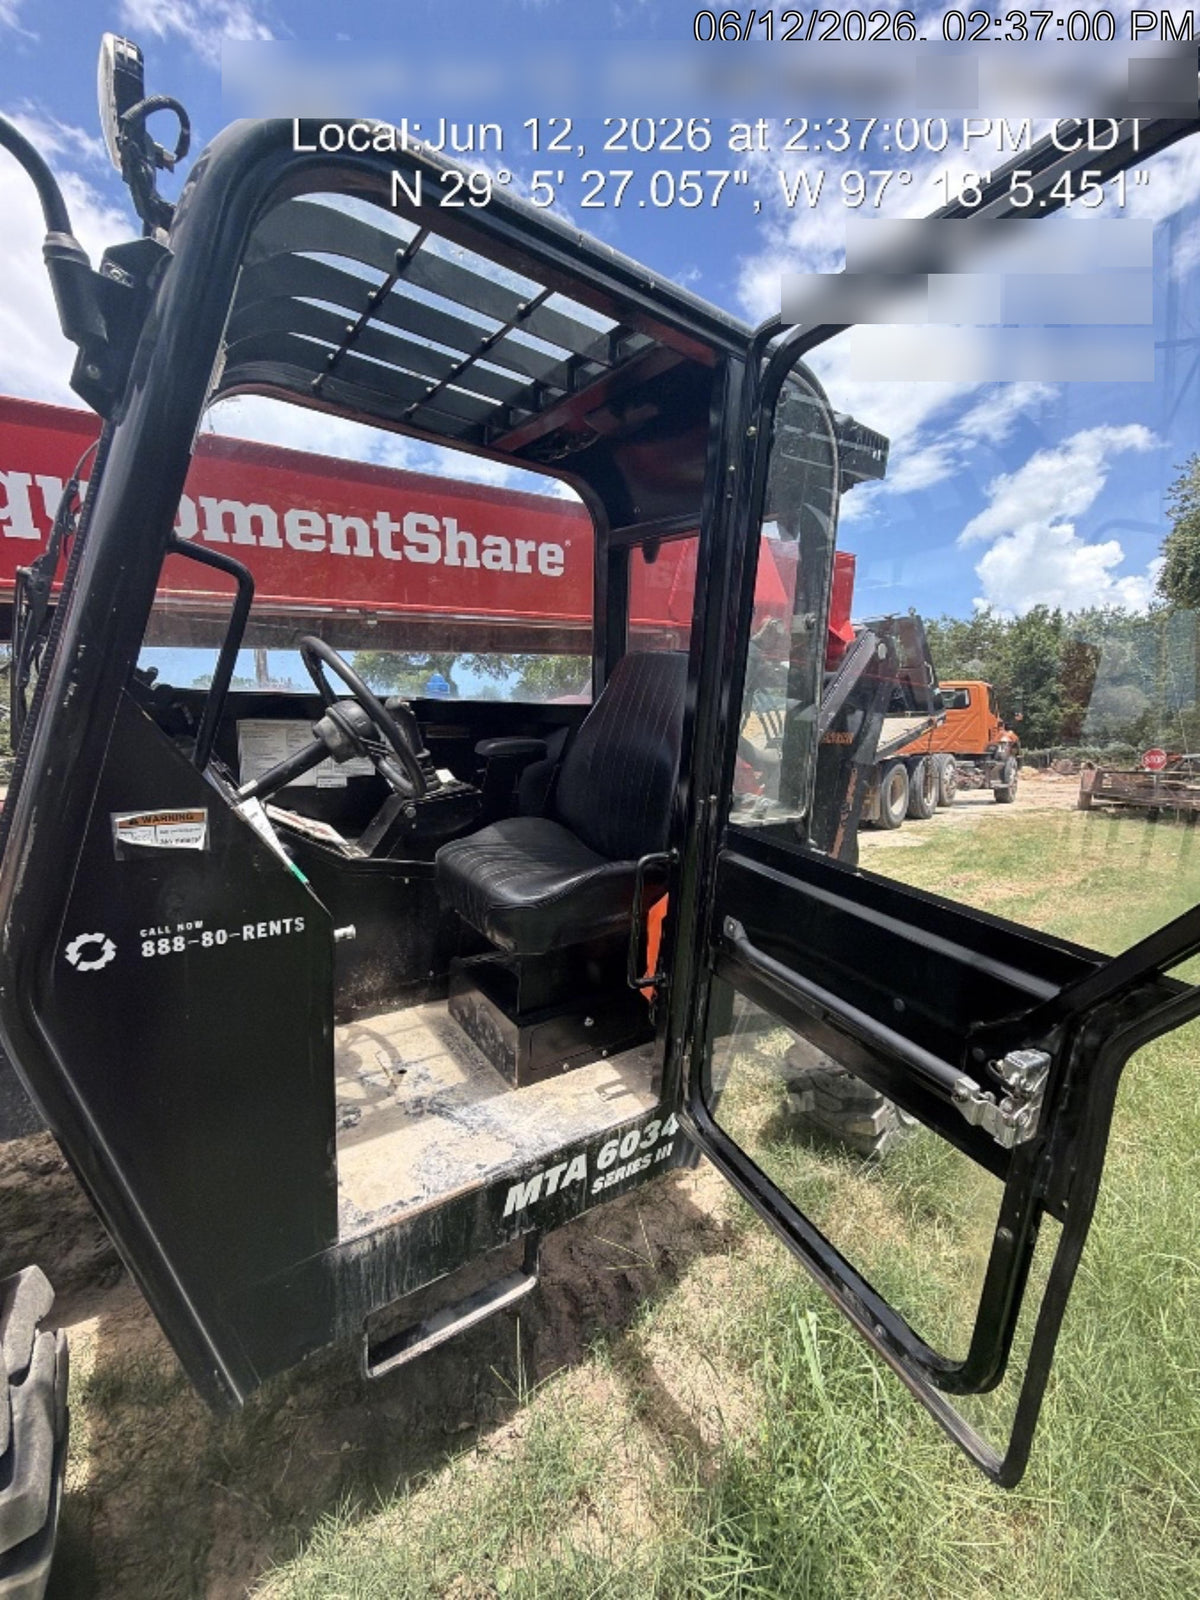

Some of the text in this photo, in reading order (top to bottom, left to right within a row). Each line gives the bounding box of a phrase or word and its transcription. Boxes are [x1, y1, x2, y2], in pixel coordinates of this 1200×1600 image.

[140, 920, 203, 938] CALL NOW
[141, 917, 305, 957] 888-80-RENTS
[503, 1112, 679, 1217] MTA 6034
[591, 1142, 674, 1195] SERIES III
